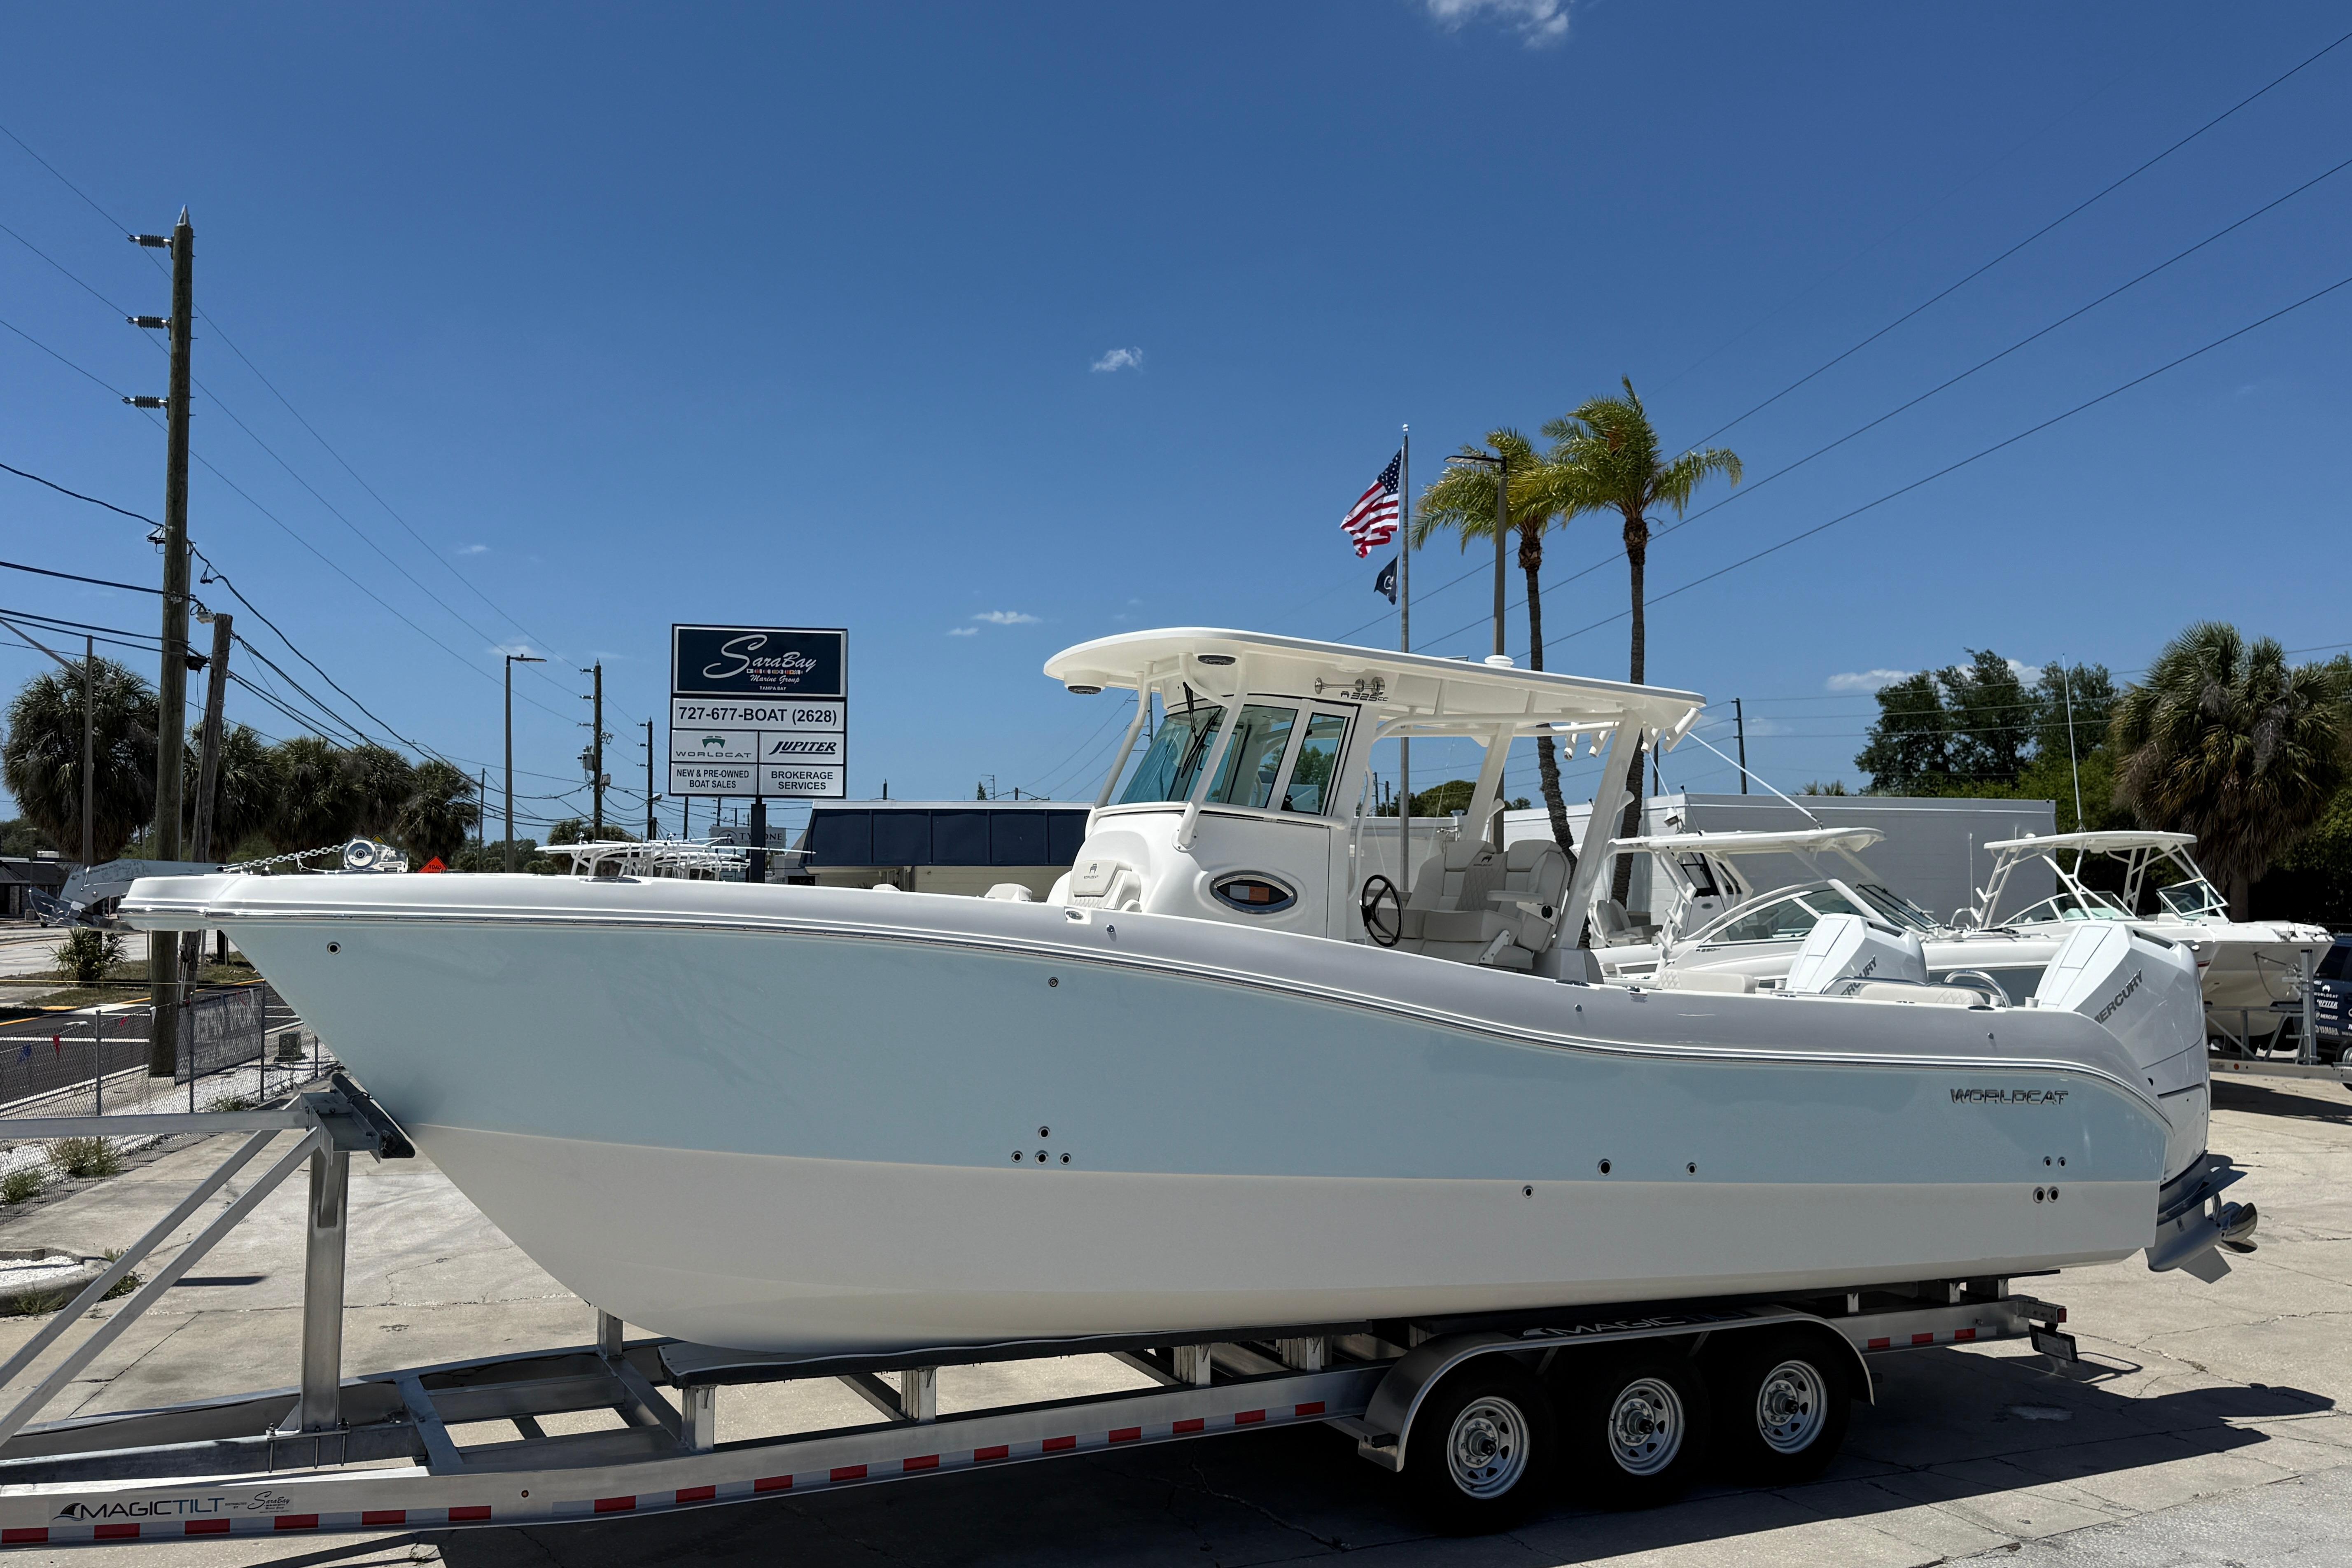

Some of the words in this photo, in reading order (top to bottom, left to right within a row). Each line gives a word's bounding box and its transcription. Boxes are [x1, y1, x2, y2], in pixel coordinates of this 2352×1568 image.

[779, 675, 800, 684] Group
[679, 707, 787, 721] 727-677-BOAT
[792, 709, 837, 726] (2628)
[768, 741, 837, 755] JUPITER
[703, 770, 749, 778] PRE-OWNED
[771, 771, 833, 780] BROKERAGE
[689, 780, 710, 788] BOAT
[712, 780, 736, 789] SALES
[778, 782, 826, 790] SERVICES
[1950, 1088, 2069, 1105] WORLDCAT
[82, 1497, 225, 1519] MAGICTILT
